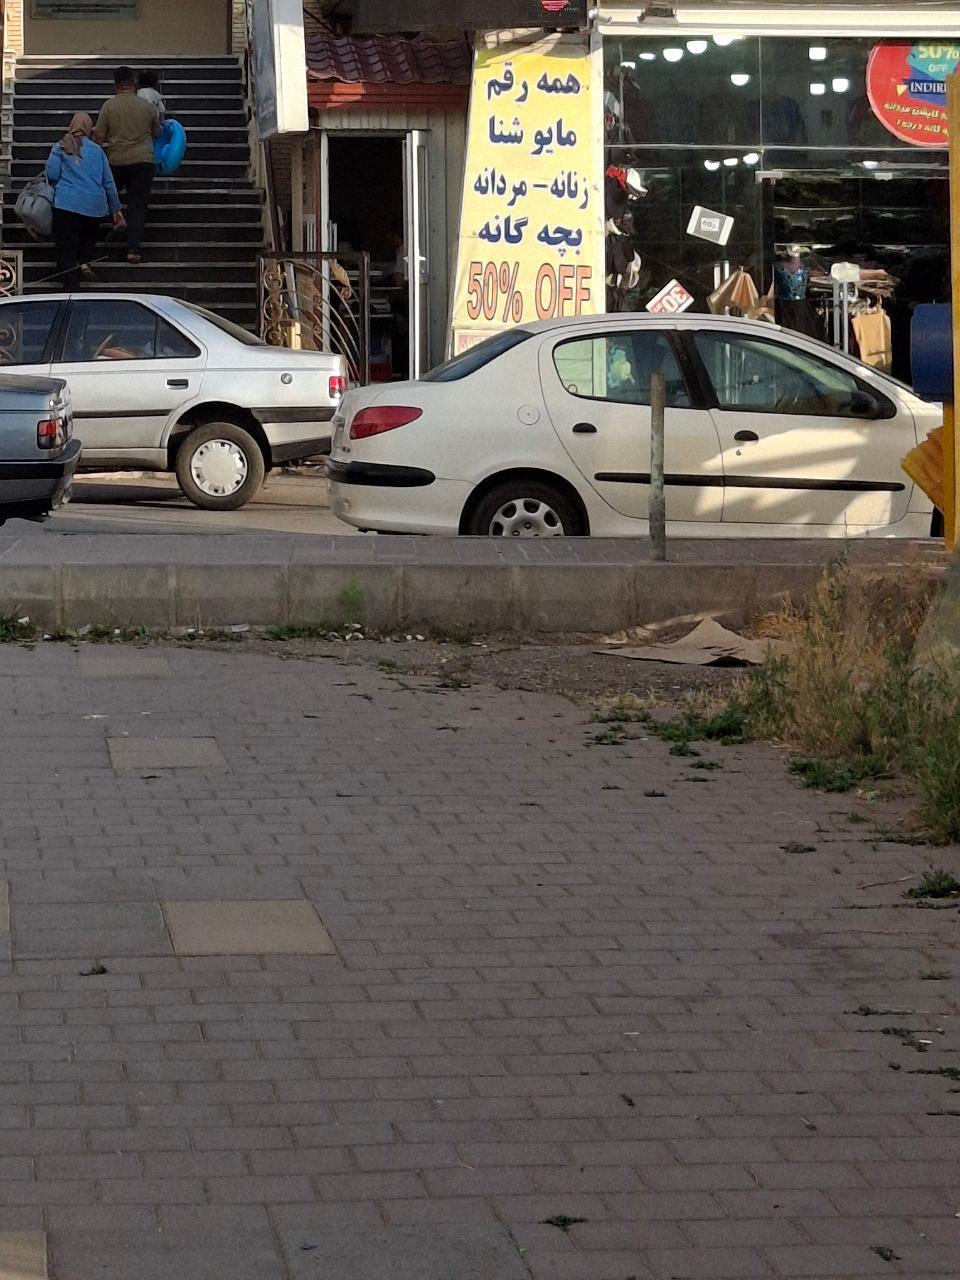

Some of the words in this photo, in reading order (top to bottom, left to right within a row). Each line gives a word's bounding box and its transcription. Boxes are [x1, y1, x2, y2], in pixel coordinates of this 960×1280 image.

[487, 61, 529, 102] رقم
[537, 72, 581, 95] همه
[489, 114, 524, 145] شنا
[530, 118, 577, 155] مایو
[474, 167, 527, 206] مردانه
[478, 214, 528, 244] گانه
[537, 223, 583, 257] بچه
[467, 261, 523, 323] 50%
[535, 263, 592, 320] OFF
